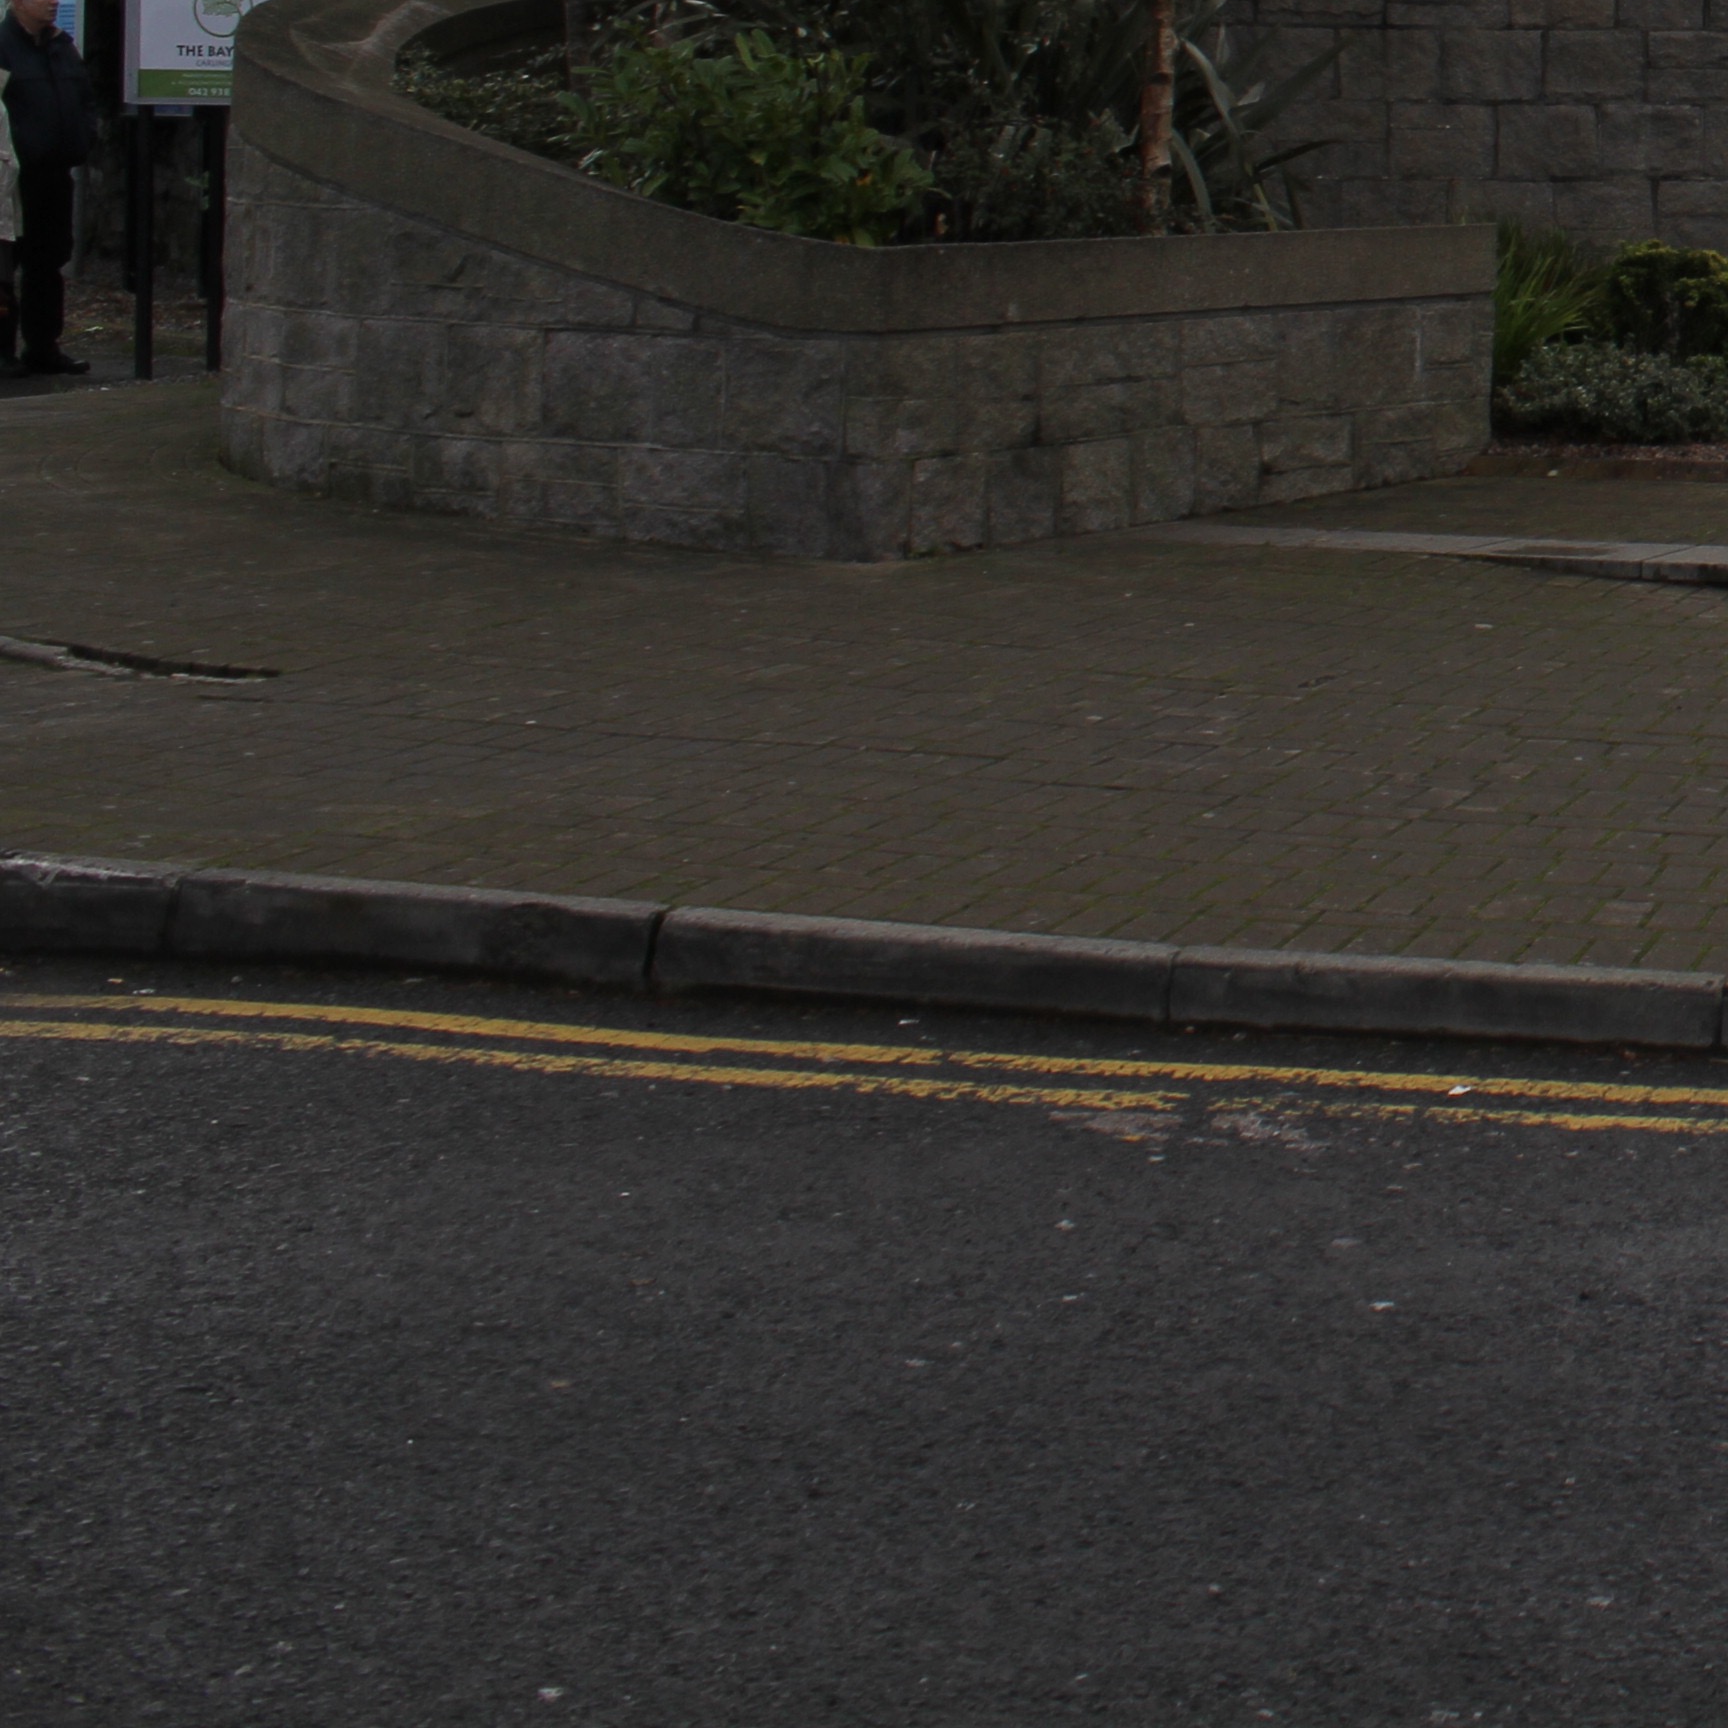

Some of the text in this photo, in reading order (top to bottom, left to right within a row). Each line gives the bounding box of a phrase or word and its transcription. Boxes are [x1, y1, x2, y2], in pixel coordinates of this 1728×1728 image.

[176, 45, 235, 57] THE BAY
[188, 87, 208, 96] 042
